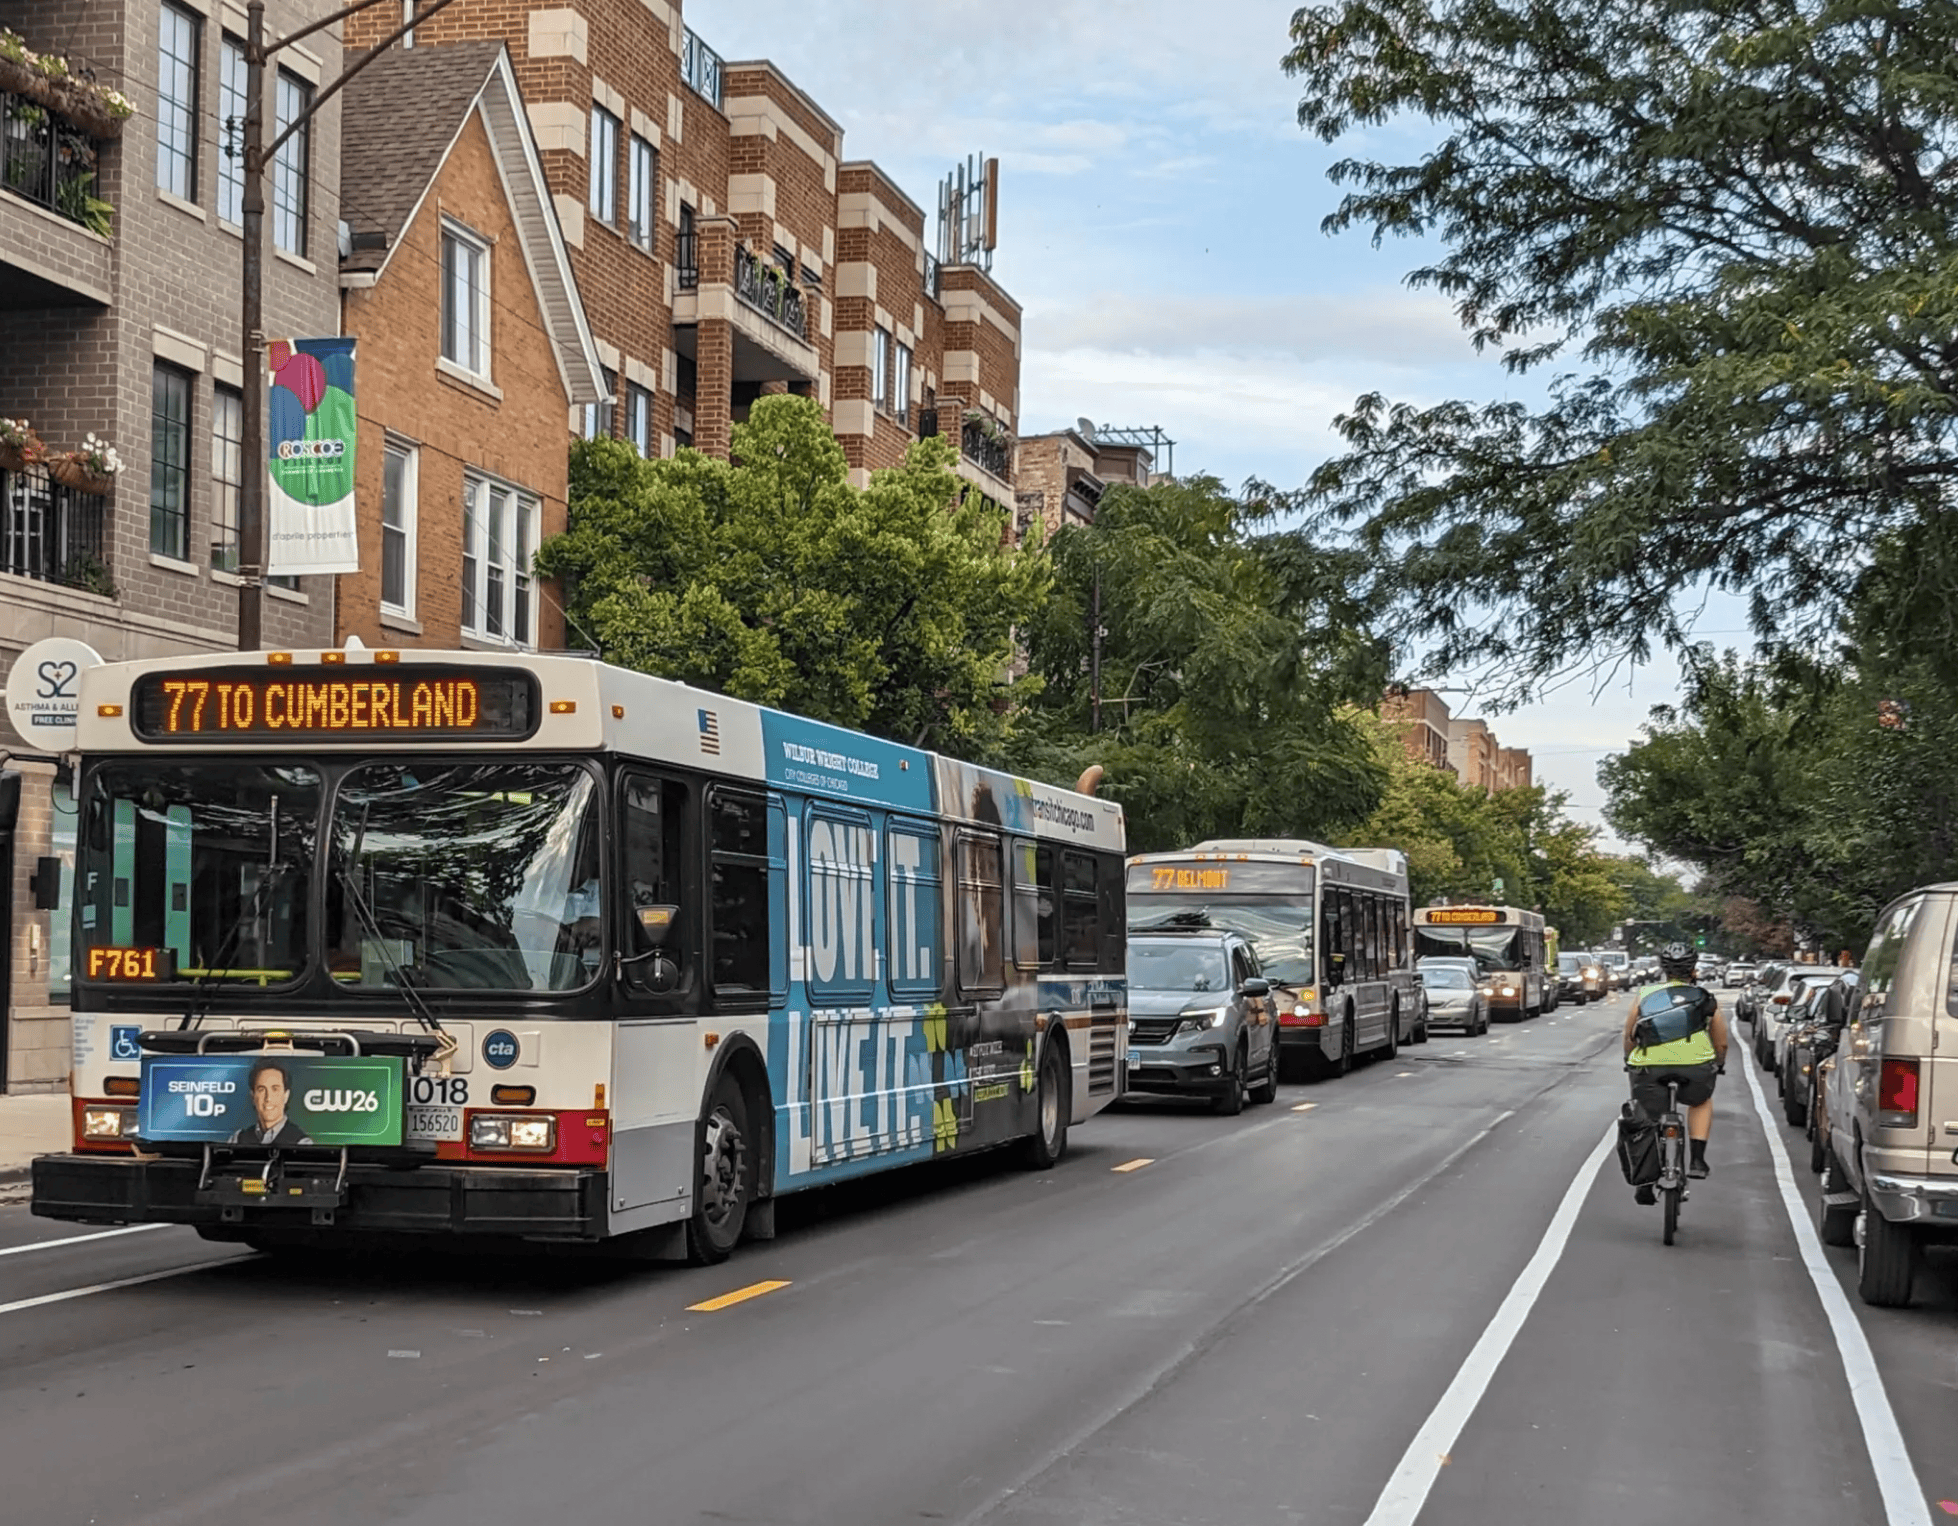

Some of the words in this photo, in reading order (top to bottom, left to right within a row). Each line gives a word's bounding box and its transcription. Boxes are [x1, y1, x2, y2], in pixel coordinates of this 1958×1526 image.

[14, 703, 50, 711] ASTHMA
[52, 703, 58, 711] &
[164, 682, 209, 731] 77
[217, 684, 253, 728] TO
[265, 682, 476, 728] CUMBERLAND
[34, 715, 53, 724] FREE
[783, 742, 816, 765] WILBUR
[848, 757, 879, 779] COLLEGE
[1152, 869, 1175, 890] 77
[788, 816, 880, 982] LOVE
[889, 832, 930, 980] IT.
[90, 949, 155, 977] F761
[488, 1042, 514, 1055] cta
[168, 1081, 236, 1093] SEINFELD
[787, 1007, 874, 1176] LIVE
[877, 1006, 922, 1153] IT.
[412, 1114, 458, 1131] 156520
